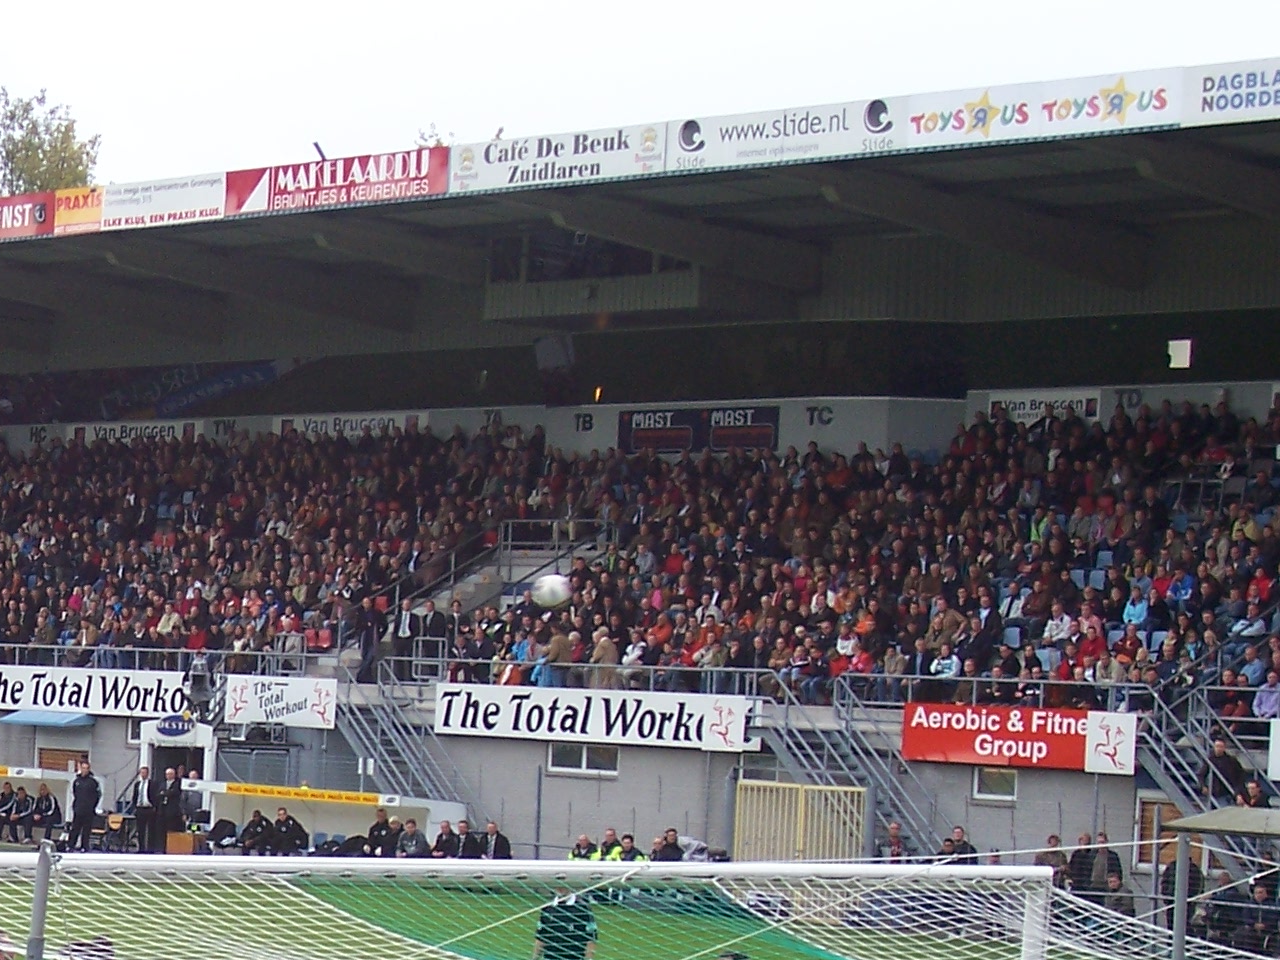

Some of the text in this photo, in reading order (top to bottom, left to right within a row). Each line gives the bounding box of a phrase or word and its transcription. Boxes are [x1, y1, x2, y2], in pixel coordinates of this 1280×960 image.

[1042, 94, 1100, 122] TOYS
[1137, 88, 1168, 112] US
[719, 108, 849, 143] www.slide.nl
[910, 106, 965, 135] TOYS
[1001, 101, 1029, 126] US
[483, 129, 630, 165] Café De Beuk
[862, 136, 893, 151] Slide
[275, 149, 430, 193] MAKELAARDIJ
[507, 159, 601, 184] Zuidlaren
[676, 155, 706, 169] Slide
[57, 193, 101, 211] PRAXIS
[274, 179, 429, 210] BRUINTJES & KEURENTJES
[104, 217, 122, 227] ELKE
[149, 213, 164, 223] EEN
[168, 210, 196, 222] PRAXIS
[303, 418, 328, 434] Van
[574, 413, 593, 432] TB
[632, 411, 674, 428] MAST
[711, 409, 755, 426] MAST
[806, 406, 833, 426] TC
[93, 425, 116, 441] Van
[30, 671, 92, 709] Total
[98, 674, 186, 713] Worko
[254, 681, 273, 695] The
[258, 689, 284, 709] Total
[264, 697, 307, 720] Workout
[440, 689, 704, 743] The Total Work
[911, 706, 1088, 735] Aerobic & Fitne
[974, 734, 1048, 763] Group
